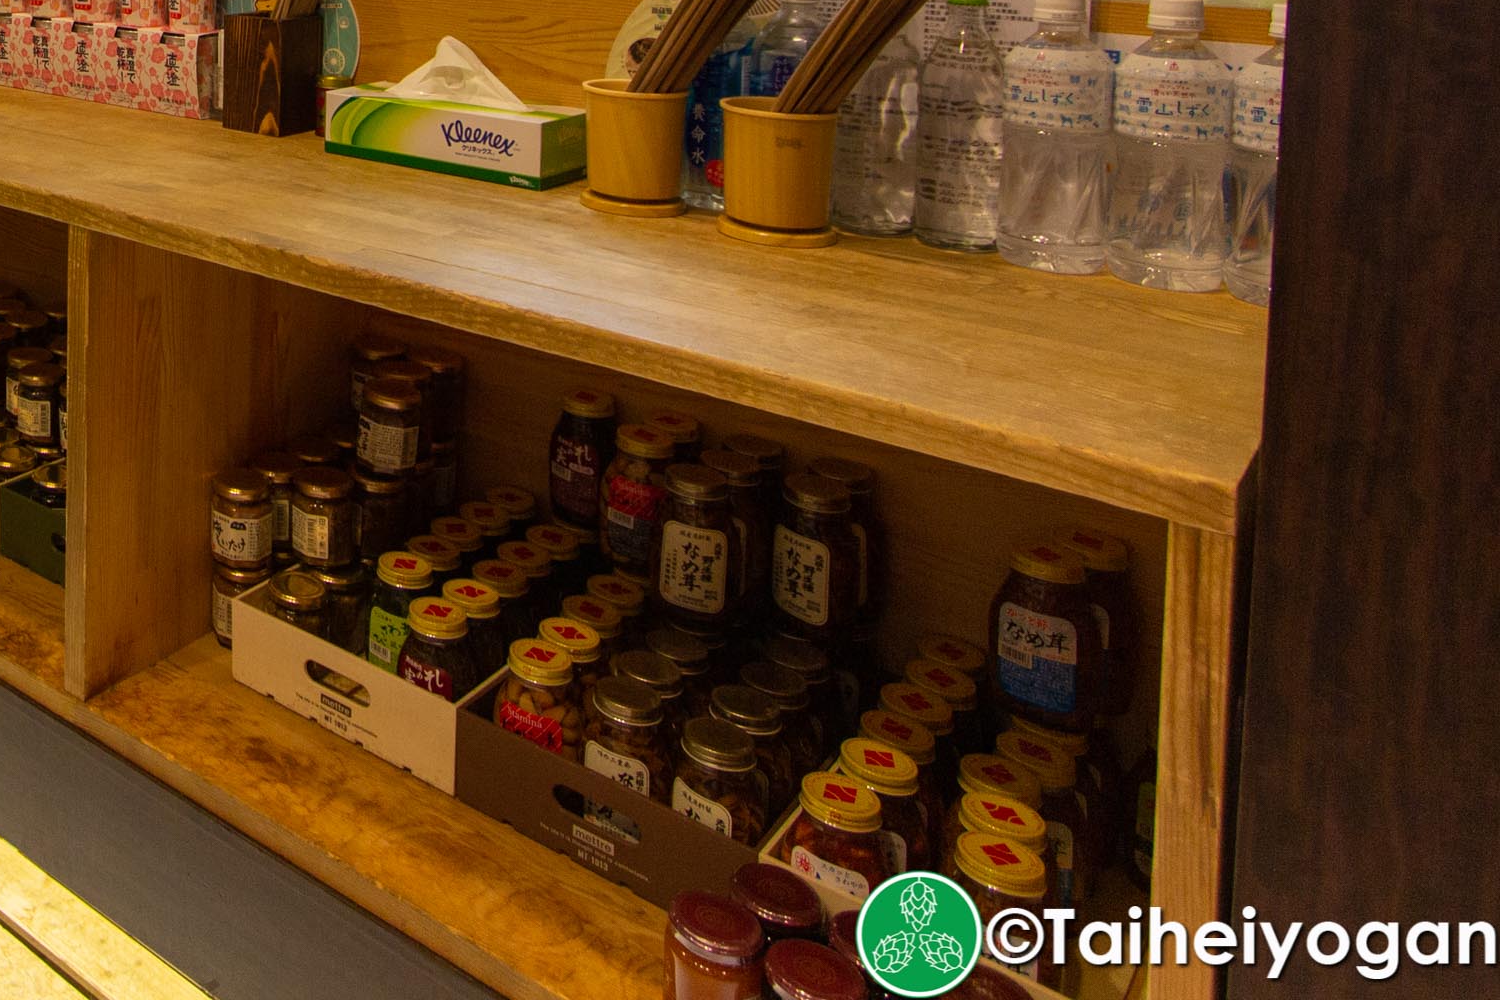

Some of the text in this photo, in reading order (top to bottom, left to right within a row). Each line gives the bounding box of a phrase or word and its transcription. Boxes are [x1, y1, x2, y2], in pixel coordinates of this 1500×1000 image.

[76, 41, 89, 73] 真澄
[165, 52, 180, 87] 真澄
[441, 119, 516, 157] Kleenex
[462, 144, 493, 155] クリネックス
[1006, 618, 1070, 654] なめ茸
[507, 707, 543, 729] Stamina
